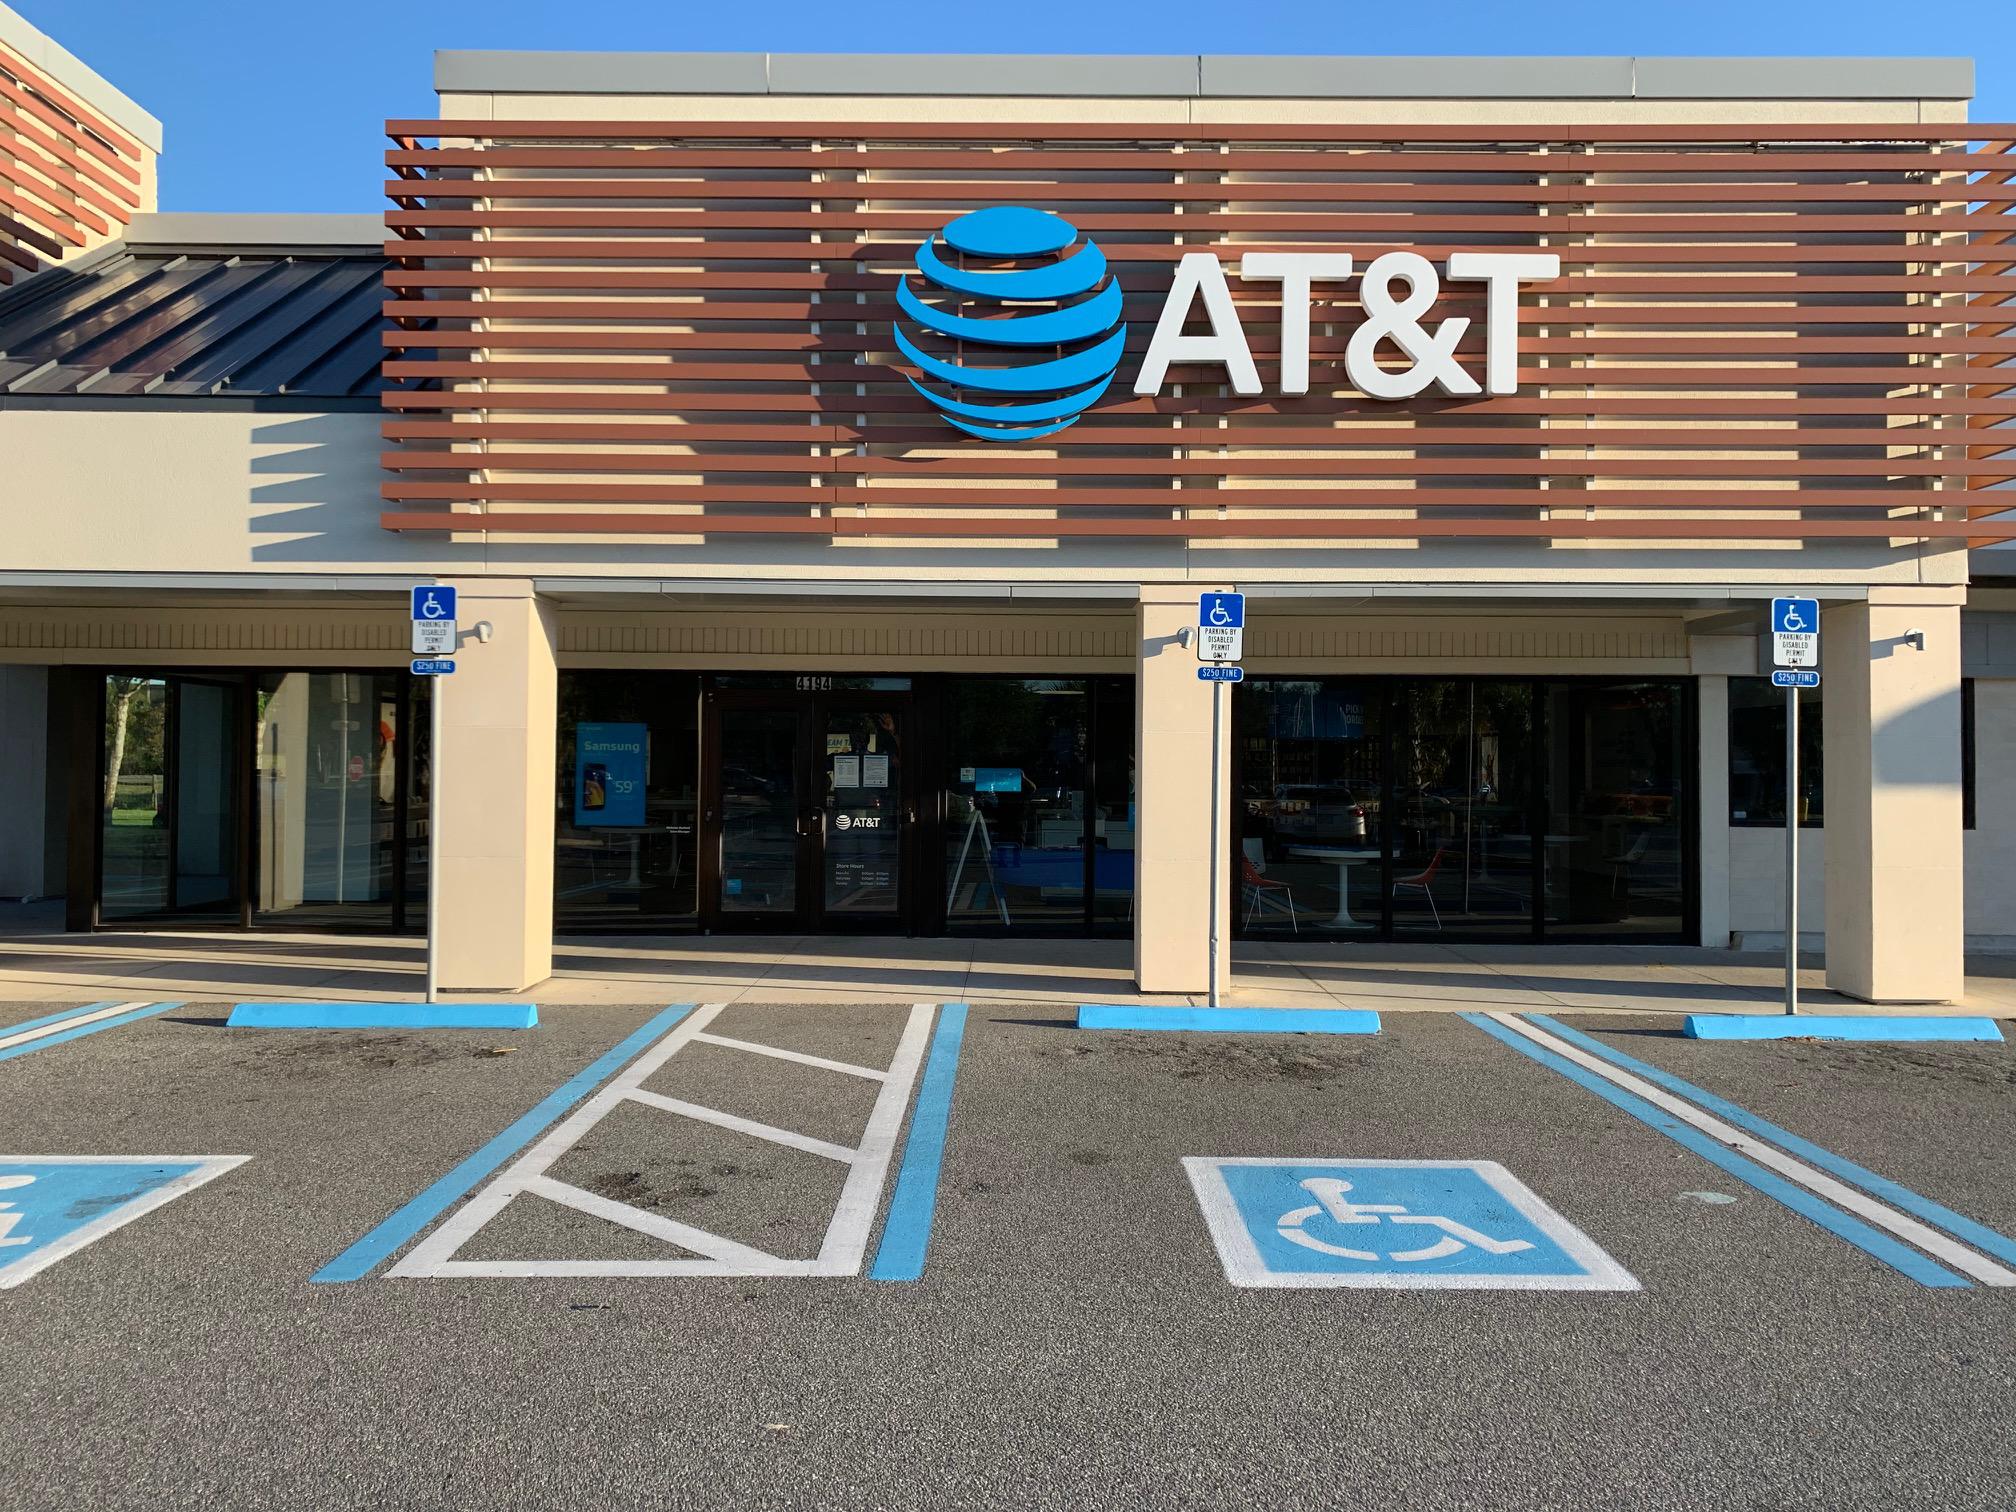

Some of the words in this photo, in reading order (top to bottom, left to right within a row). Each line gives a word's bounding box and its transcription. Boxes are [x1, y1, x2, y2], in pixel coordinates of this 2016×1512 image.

[1133, 251, 1560, 400] AT&T
[1230, 628, 1236, 636] BY
[1805, 633, 1811, 641] BY
[1782, 641, 1808, 649] DISABLED
[416, 661, 433, 670] $250
[436, 662, 451, 670] FINE
[1202, 668, 1220, 677] $250
[1222, 669, 1238, 678] FINE
[1778, 673, 1795, 682] $250
[1798, 673, 1814, 683] FINE
[796, 676, 831, 690] 4194
[584, 740, 640, 754] Samsung
[852, 817, 881, 827] AT&T
